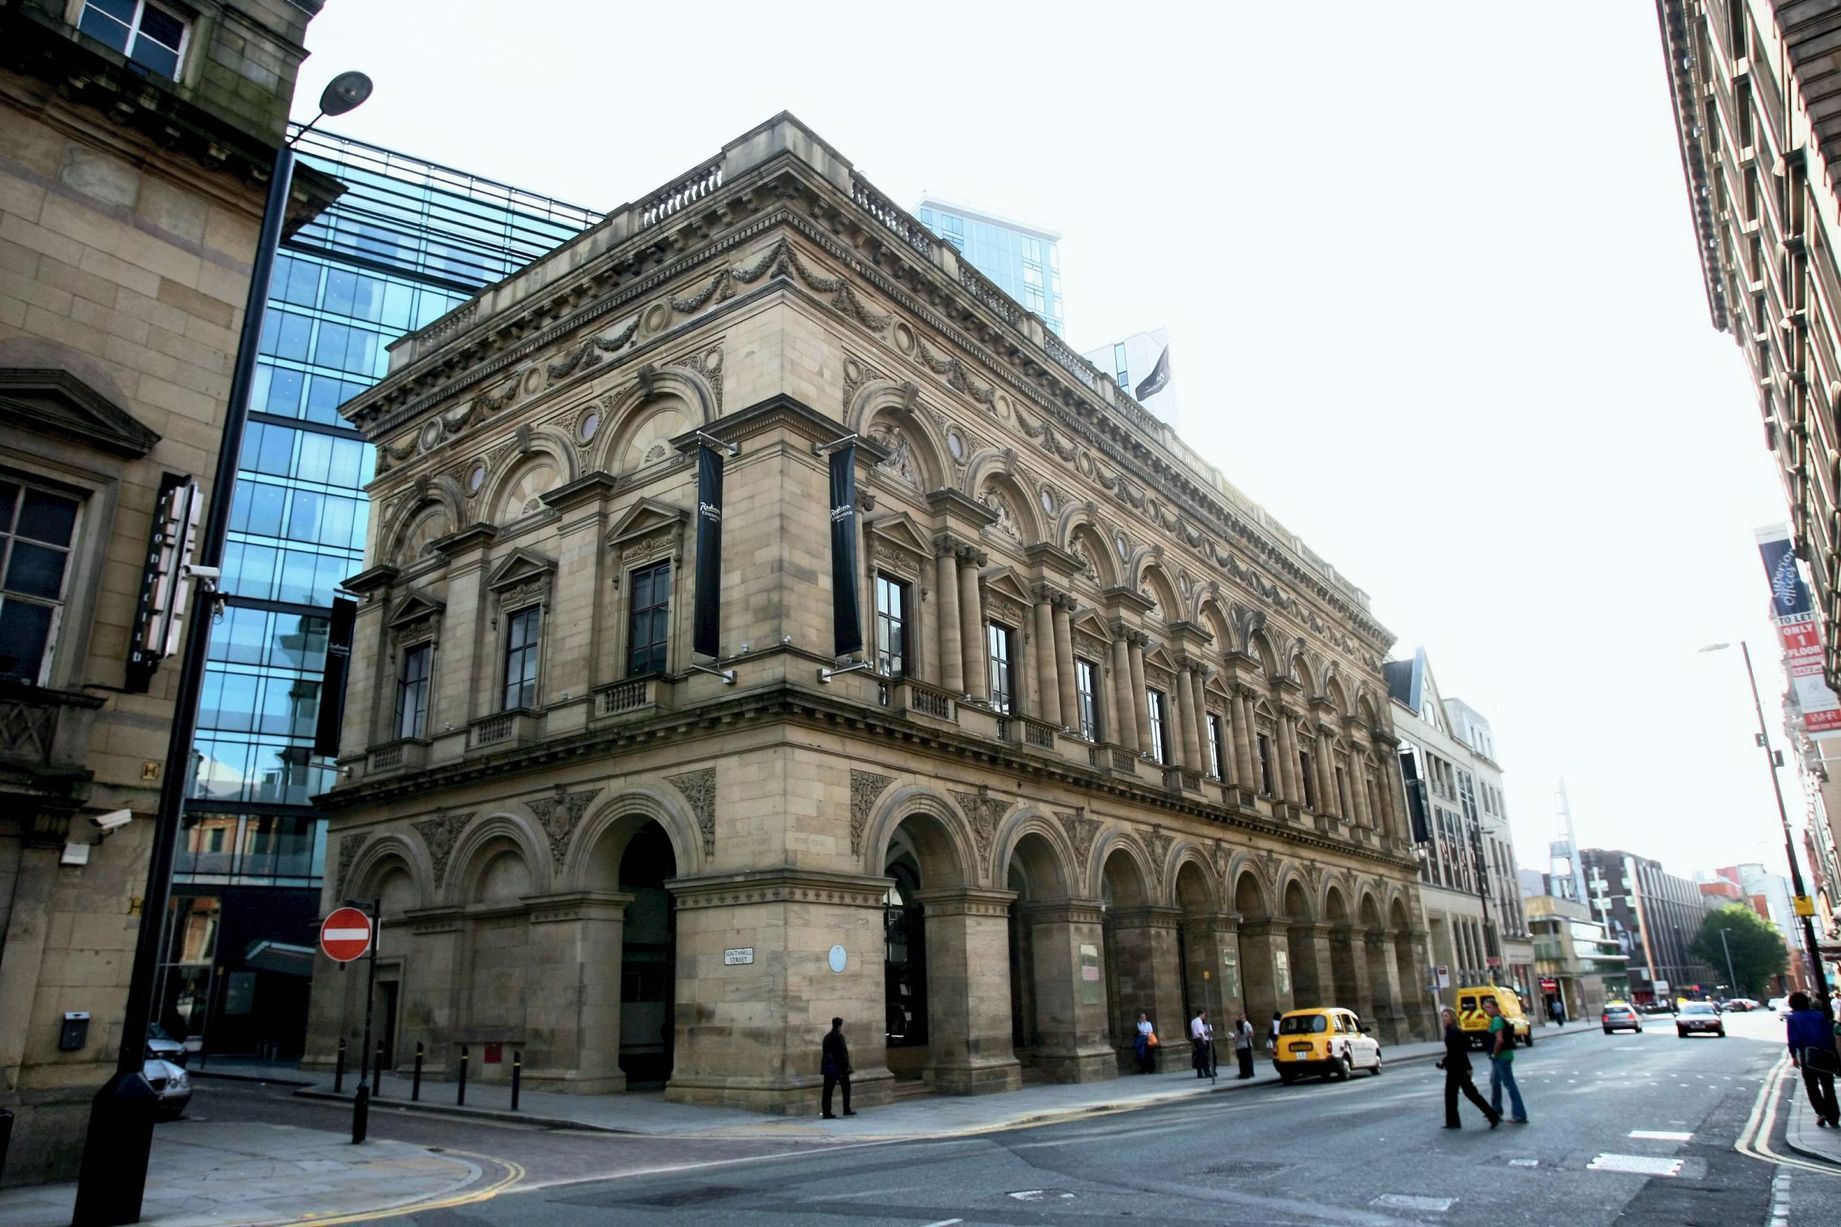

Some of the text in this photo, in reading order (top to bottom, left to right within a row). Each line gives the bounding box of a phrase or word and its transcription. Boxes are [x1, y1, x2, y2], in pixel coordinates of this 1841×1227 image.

[1779, 612, 1812, 625] TO LET
[1783, 623, 1813, 636] ONLY
[1797, 634, 1807, 646] 1
[1788, 645, 1821, 657] FLOOR
[144, 764, 157, 775] H
